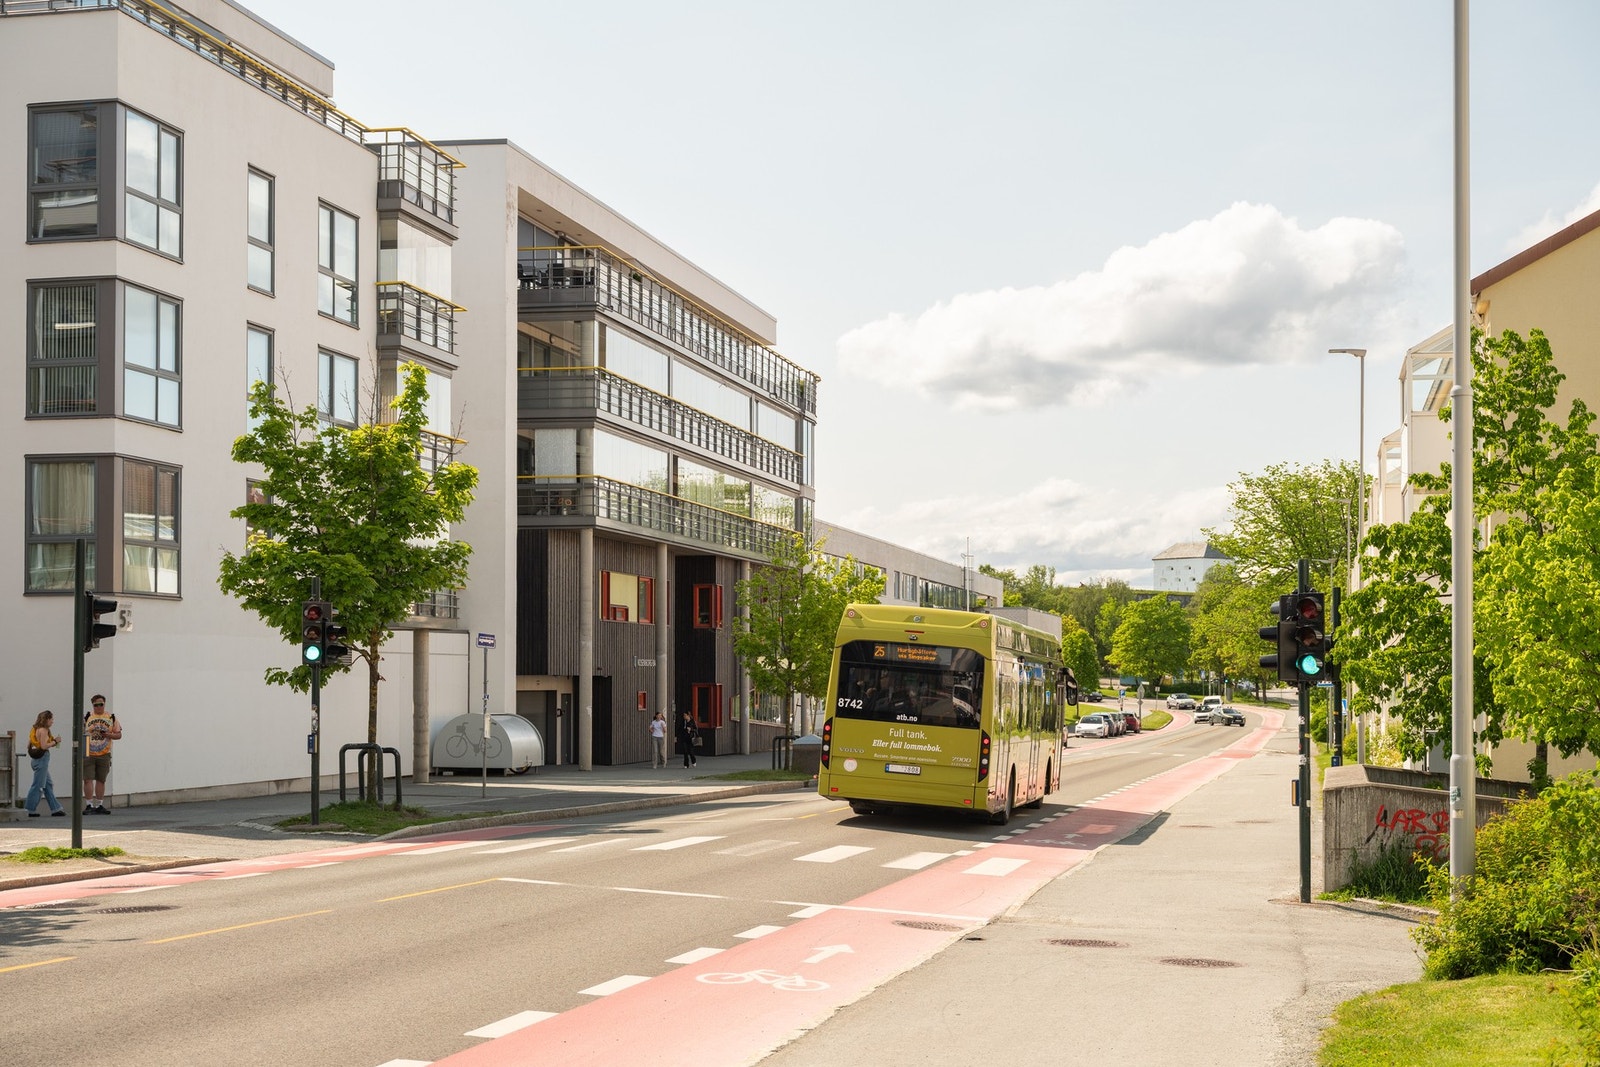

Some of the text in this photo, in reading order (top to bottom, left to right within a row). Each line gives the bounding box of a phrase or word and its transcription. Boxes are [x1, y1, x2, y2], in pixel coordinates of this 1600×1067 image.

[874, 645, 885, 657] 25
[838, 697, 863, 709] 8742
[896, 713, 918, 722] atb.no
[889, 728, 927, 740] Full tank.
[839, 746, 865, 754] VOLVO
[872, 739, 942, 752] Eller full lommebok.
